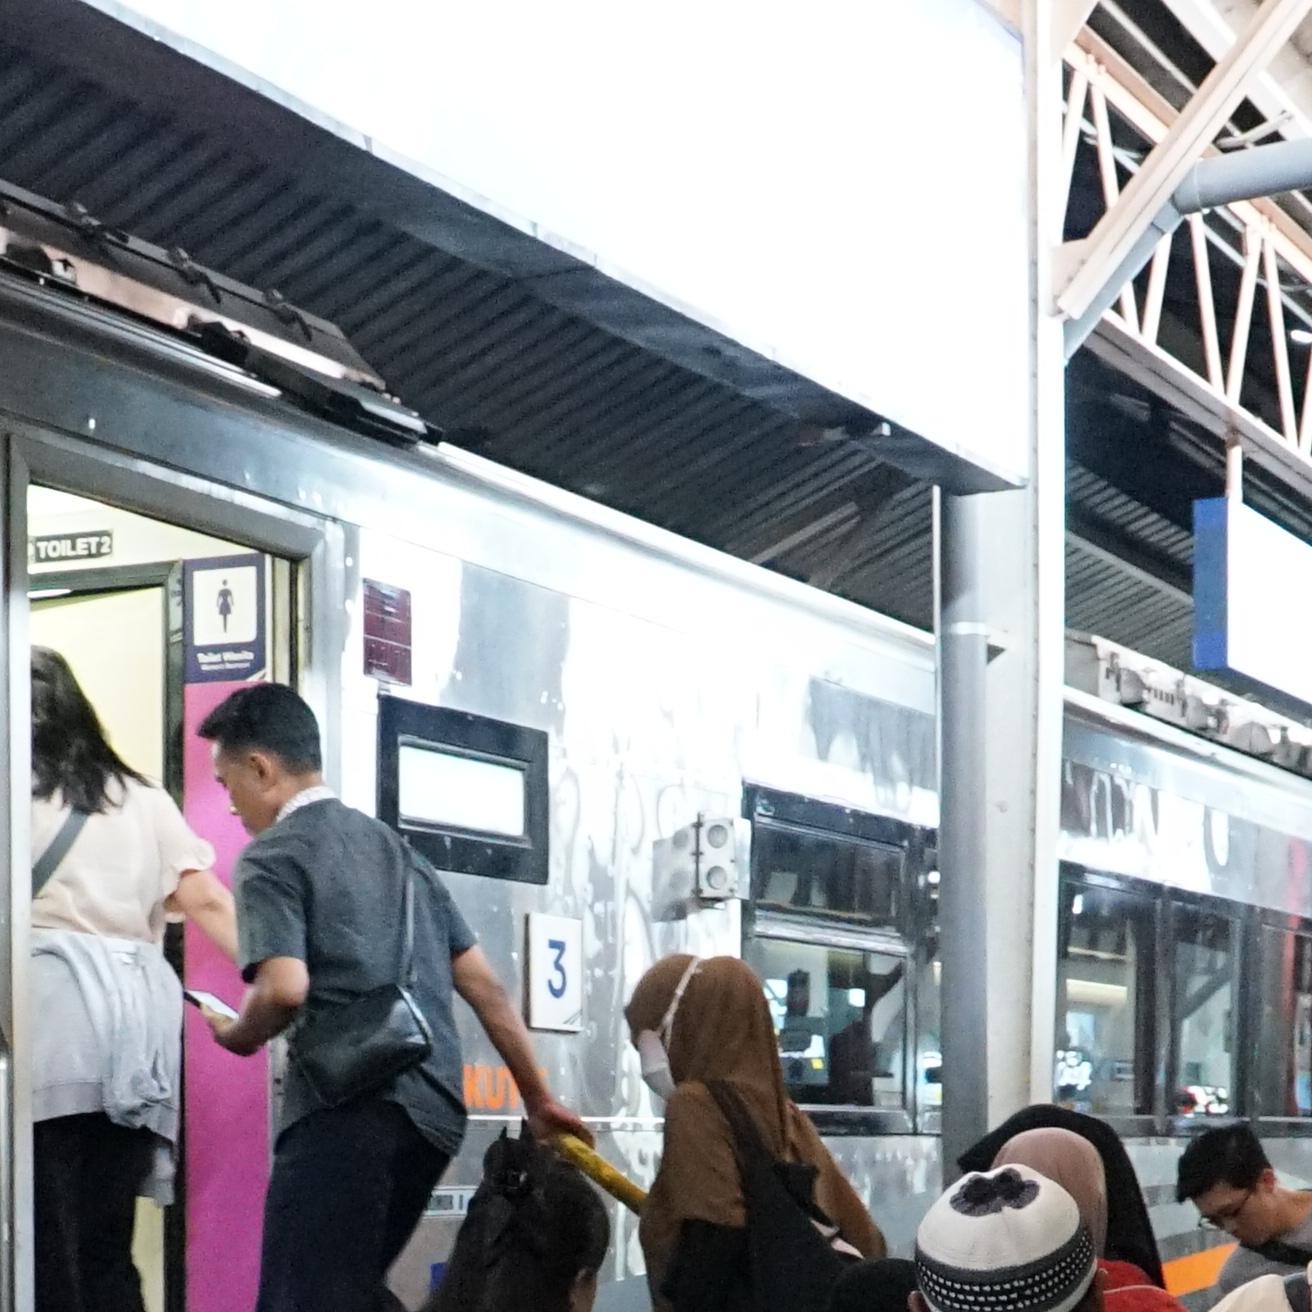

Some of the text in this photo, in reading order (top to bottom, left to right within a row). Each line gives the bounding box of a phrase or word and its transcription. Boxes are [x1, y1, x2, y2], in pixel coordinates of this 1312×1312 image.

[37, 536, 112, 559] TOILET 2
[548, 939, 566, 999] 3
